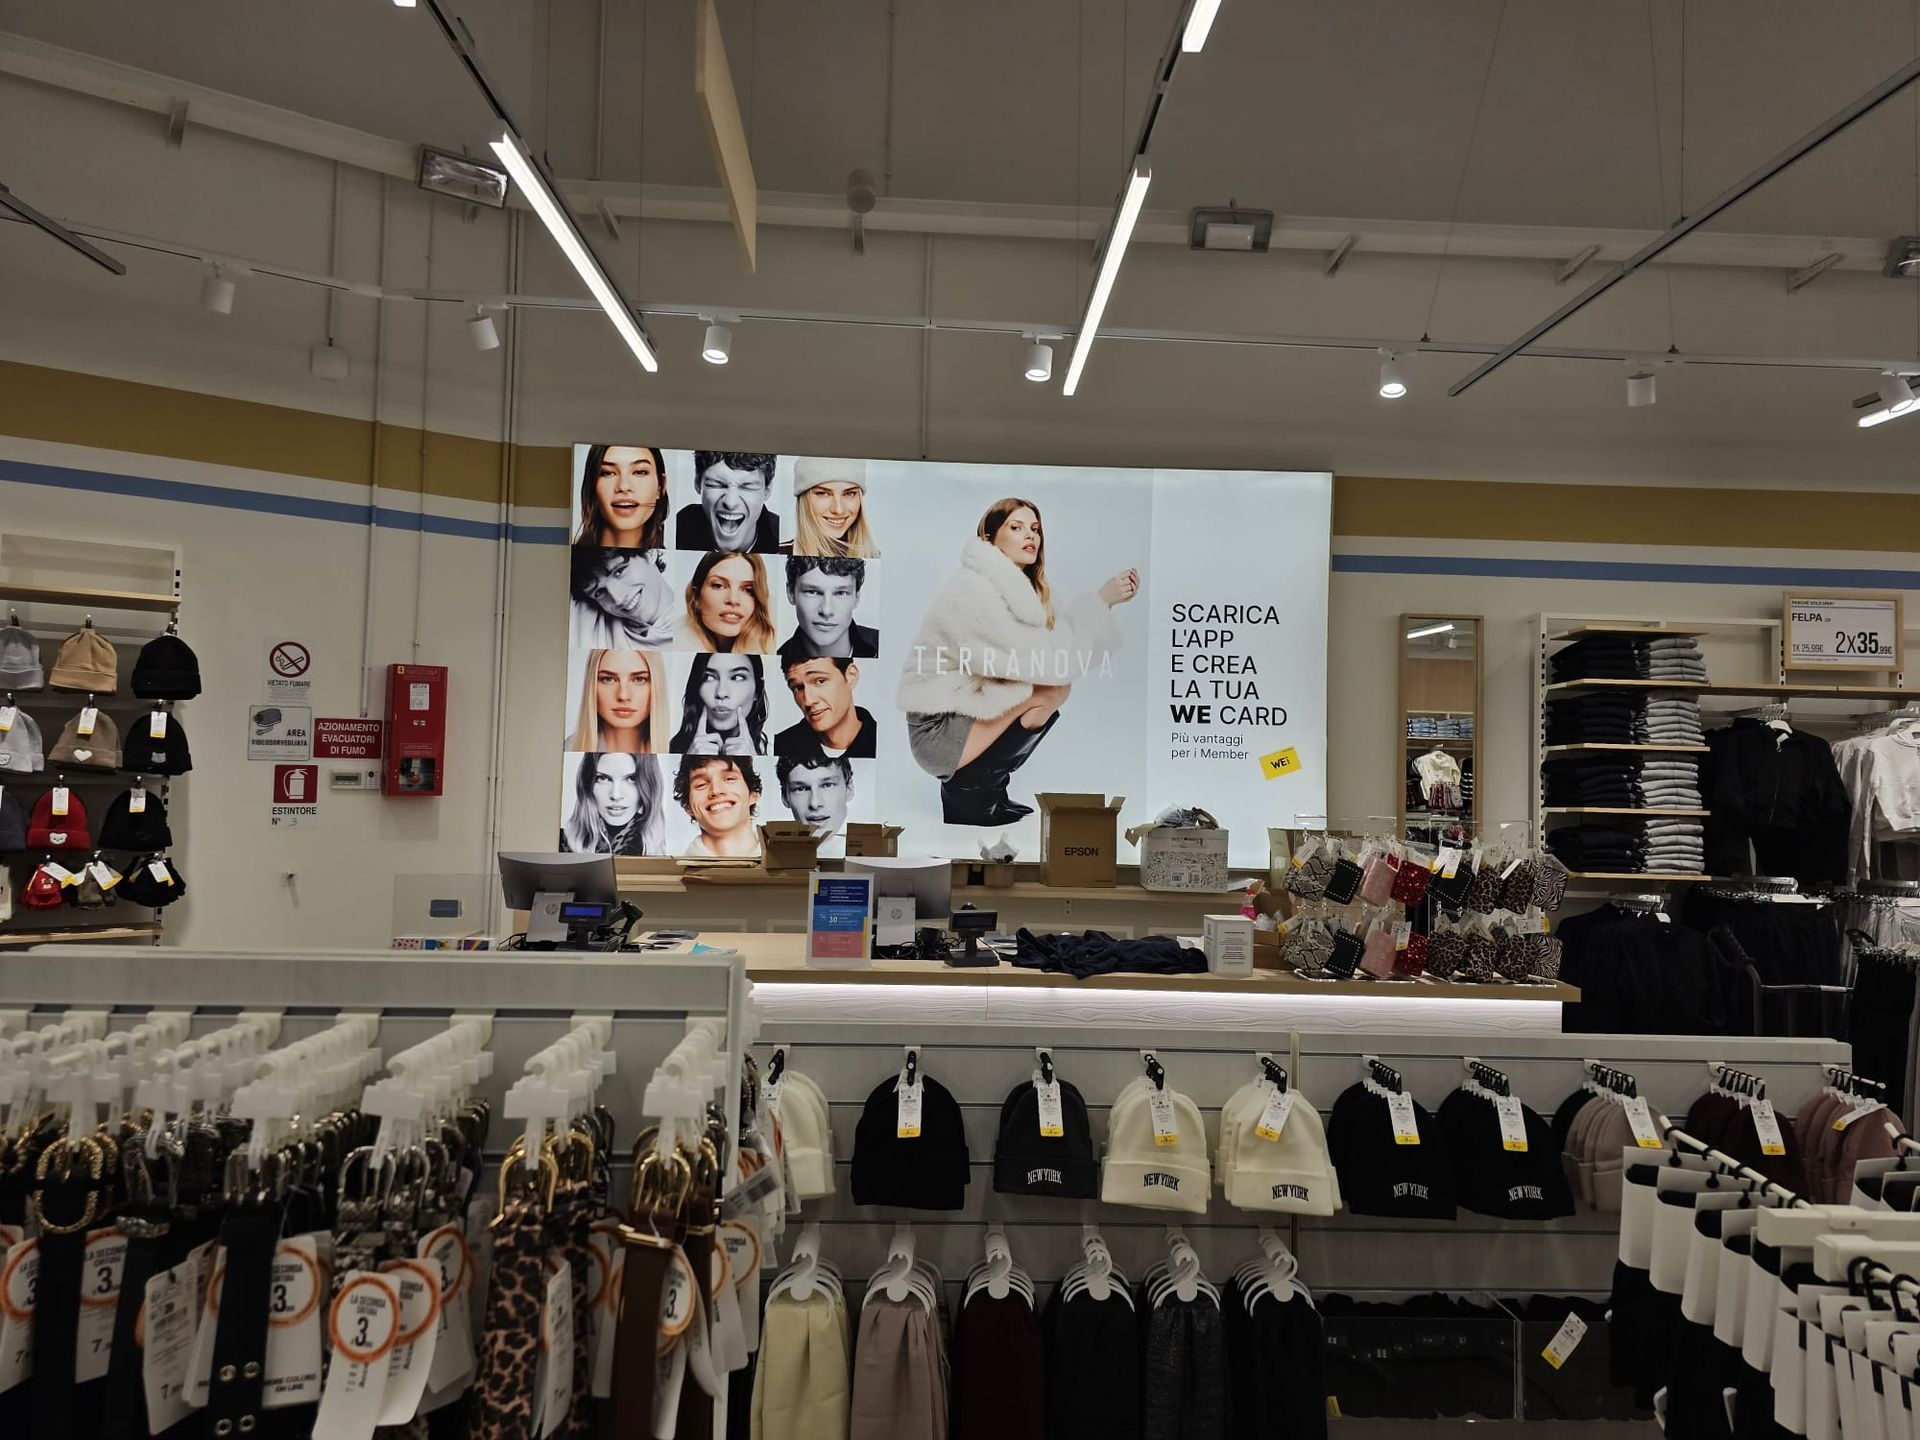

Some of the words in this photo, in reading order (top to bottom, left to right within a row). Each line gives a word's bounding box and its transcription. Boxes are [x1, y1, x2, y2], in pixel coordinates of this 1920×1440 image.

[1172, 603, 1280, 625] SCARICA
[1791, 613, 1823, 622] FELPA
[1171, 628, 1234, 648] L'APP
[913, 645, 1114, 680] TERRANOVA
[1171, 654, 1185, 673] E
[1192, 654, 1258, 675] CREA
[267, 679, 289, 687] VIETATO
[290, 680, 312, 688] FUMARE
[1171, 679, 1201, 698] LA
[1209, 680, 1260, 700] TUA
[1170, 704, 1211, 724] WE
[1219, 705, 1288, 726] CARD
[286, 728, 306, 737] AREA
[317, 722, 380, 732] AZIONAMENTO
[251, 739, 308, 747] VIDEOSORVEGLIATA
[321, 733, 376, 744] EVACUATORI
[1171, 732, 1189, 743] Più
[1193, 734, 1243, 746] vantaggi
[330, 745, 339, 755] DI
[341, 746, 366, 755] FUMO
[1171, 749, 1190, 760] per
[1193, 748, 1197, 758] i
[1200, 748, 1249, 760] Member
[272, 806, 318, 815] ESTINTORE
[1064, 846, 1099, 857] EPSON
[1027, 1169, 1043, 1185] NEW
[1043, 1168, 1063, 1185] YORK
[1143, 1172, 1159, 1188] NEW
[1158, 1173, 1180, 1191] YORK
[1271, 1184, 1289, 1200] NEW
[1289, 1184, 1309, 1202] YORK
[1393, 1182, 1409, 1198] NEW
[1409, 1183, 1429, 1200] YORK
[1508, 1185, 1523, 1202] NEW
[1523, 1185, 1544, 1201] YORK
[97, 1265, 113, 1294] 3
[273, 1284, 287, 1313] 3
[355, 1316, 369, 1347] 3
